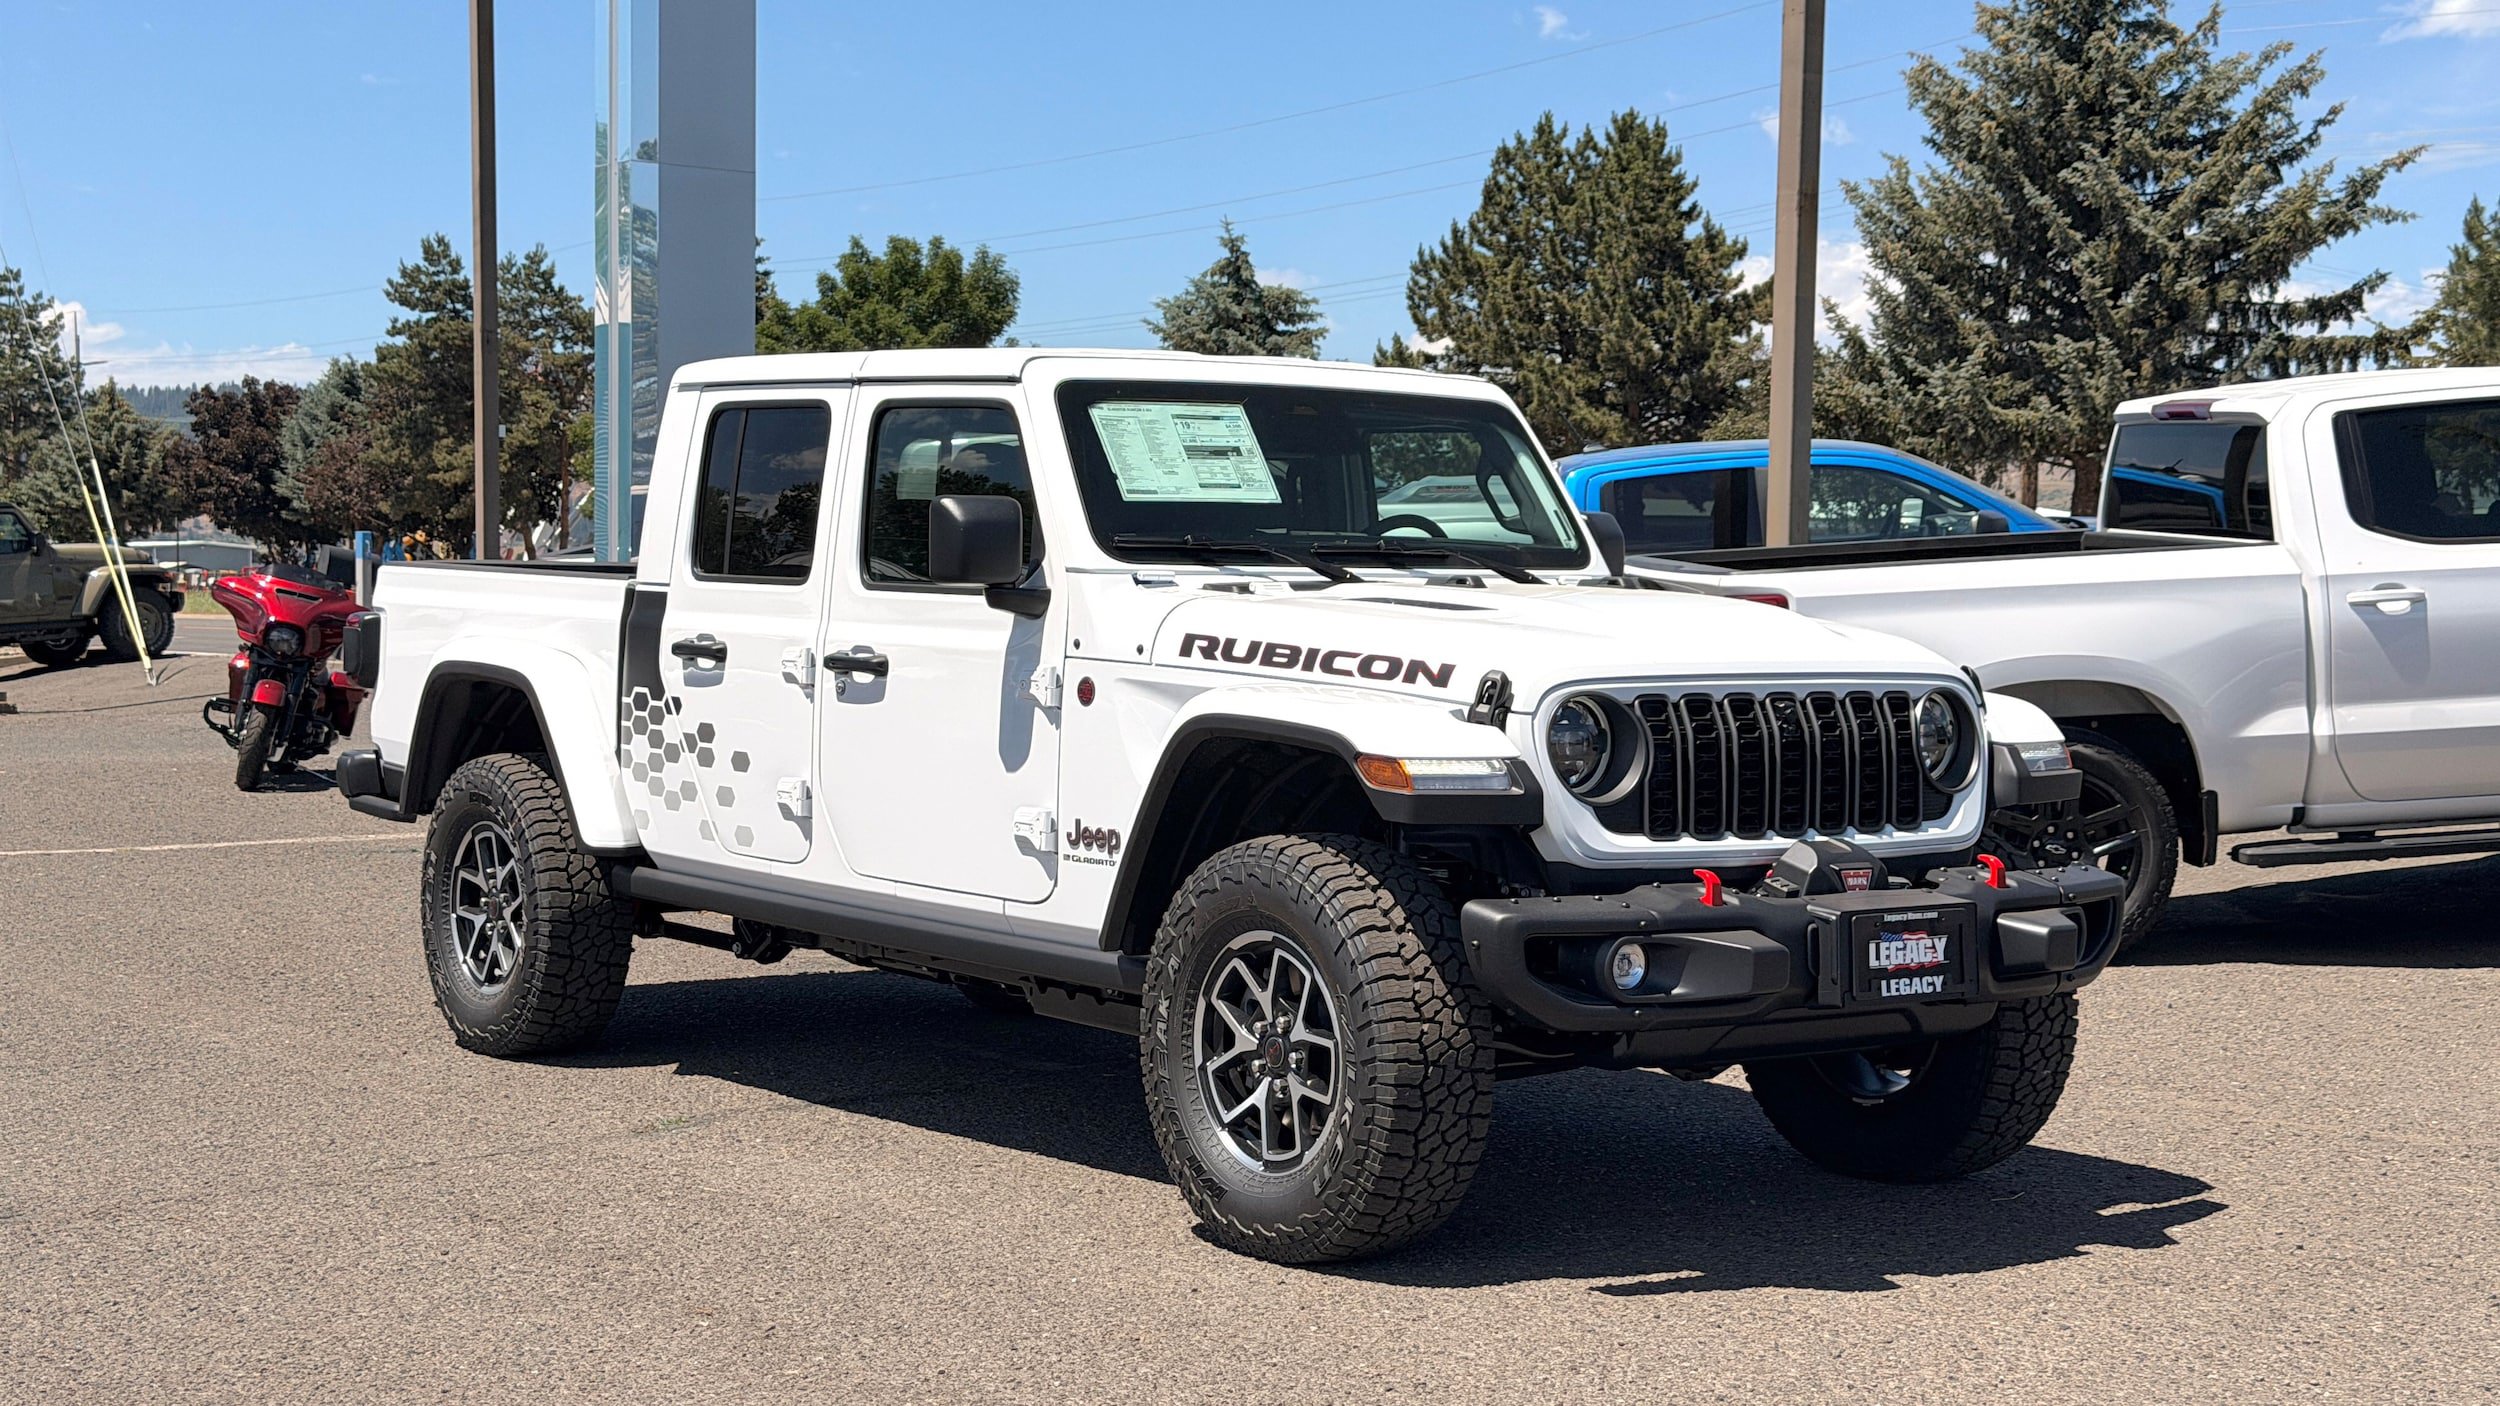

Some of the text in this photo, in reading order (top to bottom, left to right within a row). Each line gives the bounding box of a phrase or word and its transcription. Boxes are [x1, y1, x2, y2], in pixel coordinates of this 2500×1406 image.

[1178, 632, 1457, 688] RUBICON
[1066, 818, 1121, 859] Jeep
[1868, 937, 1948, 967] LEGACY
[1880, 975, 1945, 997] LEGACY
[1155, 982, 1229, 1202] WILDPEAK
